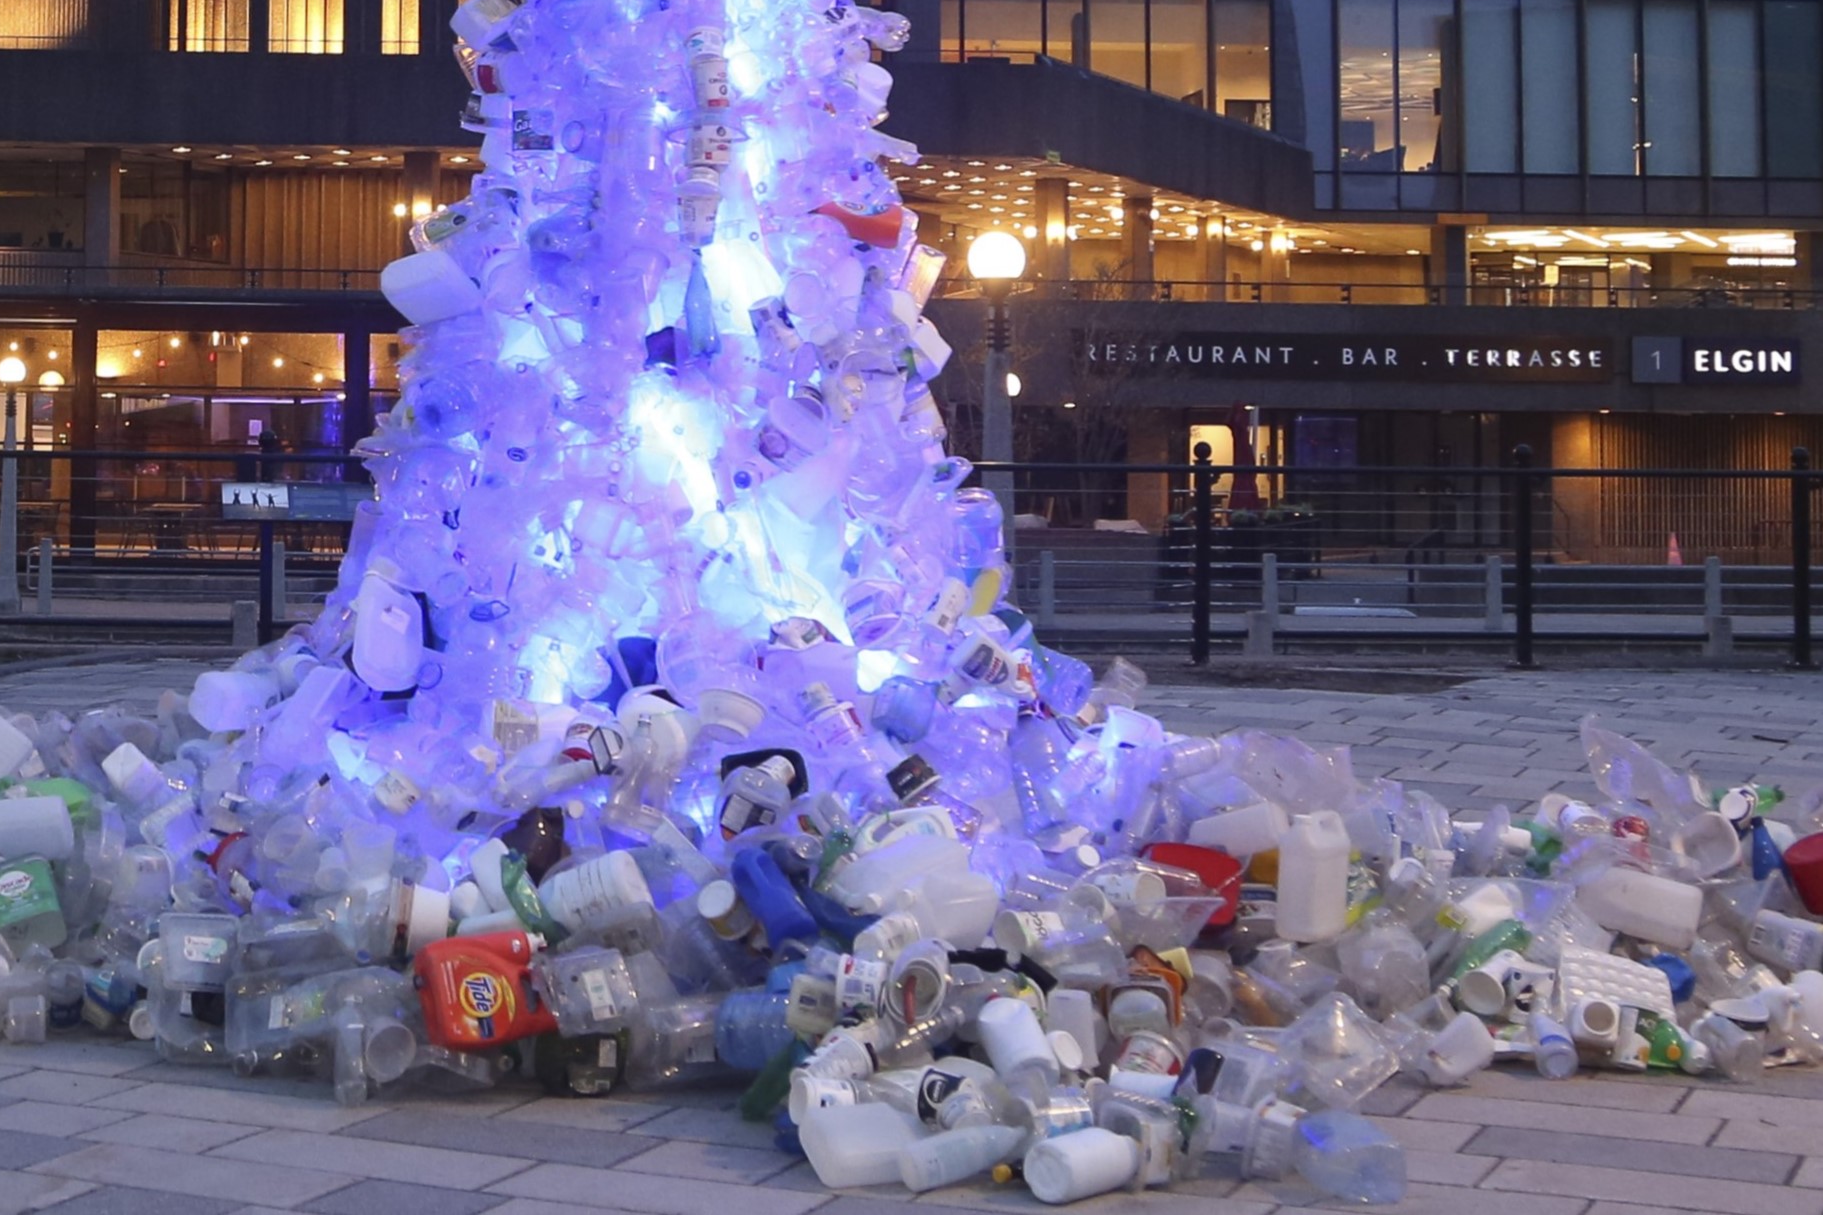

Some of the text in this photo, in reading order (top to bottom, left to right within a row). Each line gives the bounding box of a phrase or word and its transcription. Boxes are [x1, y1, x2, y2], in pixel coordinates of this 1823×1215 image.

[1088, 344, 1602, 368] RESTAURANT BAR TERRASSE
[1650, 349, 1793, 373] 1 ELGIN
[465, 976, 493, 1013] Tide
